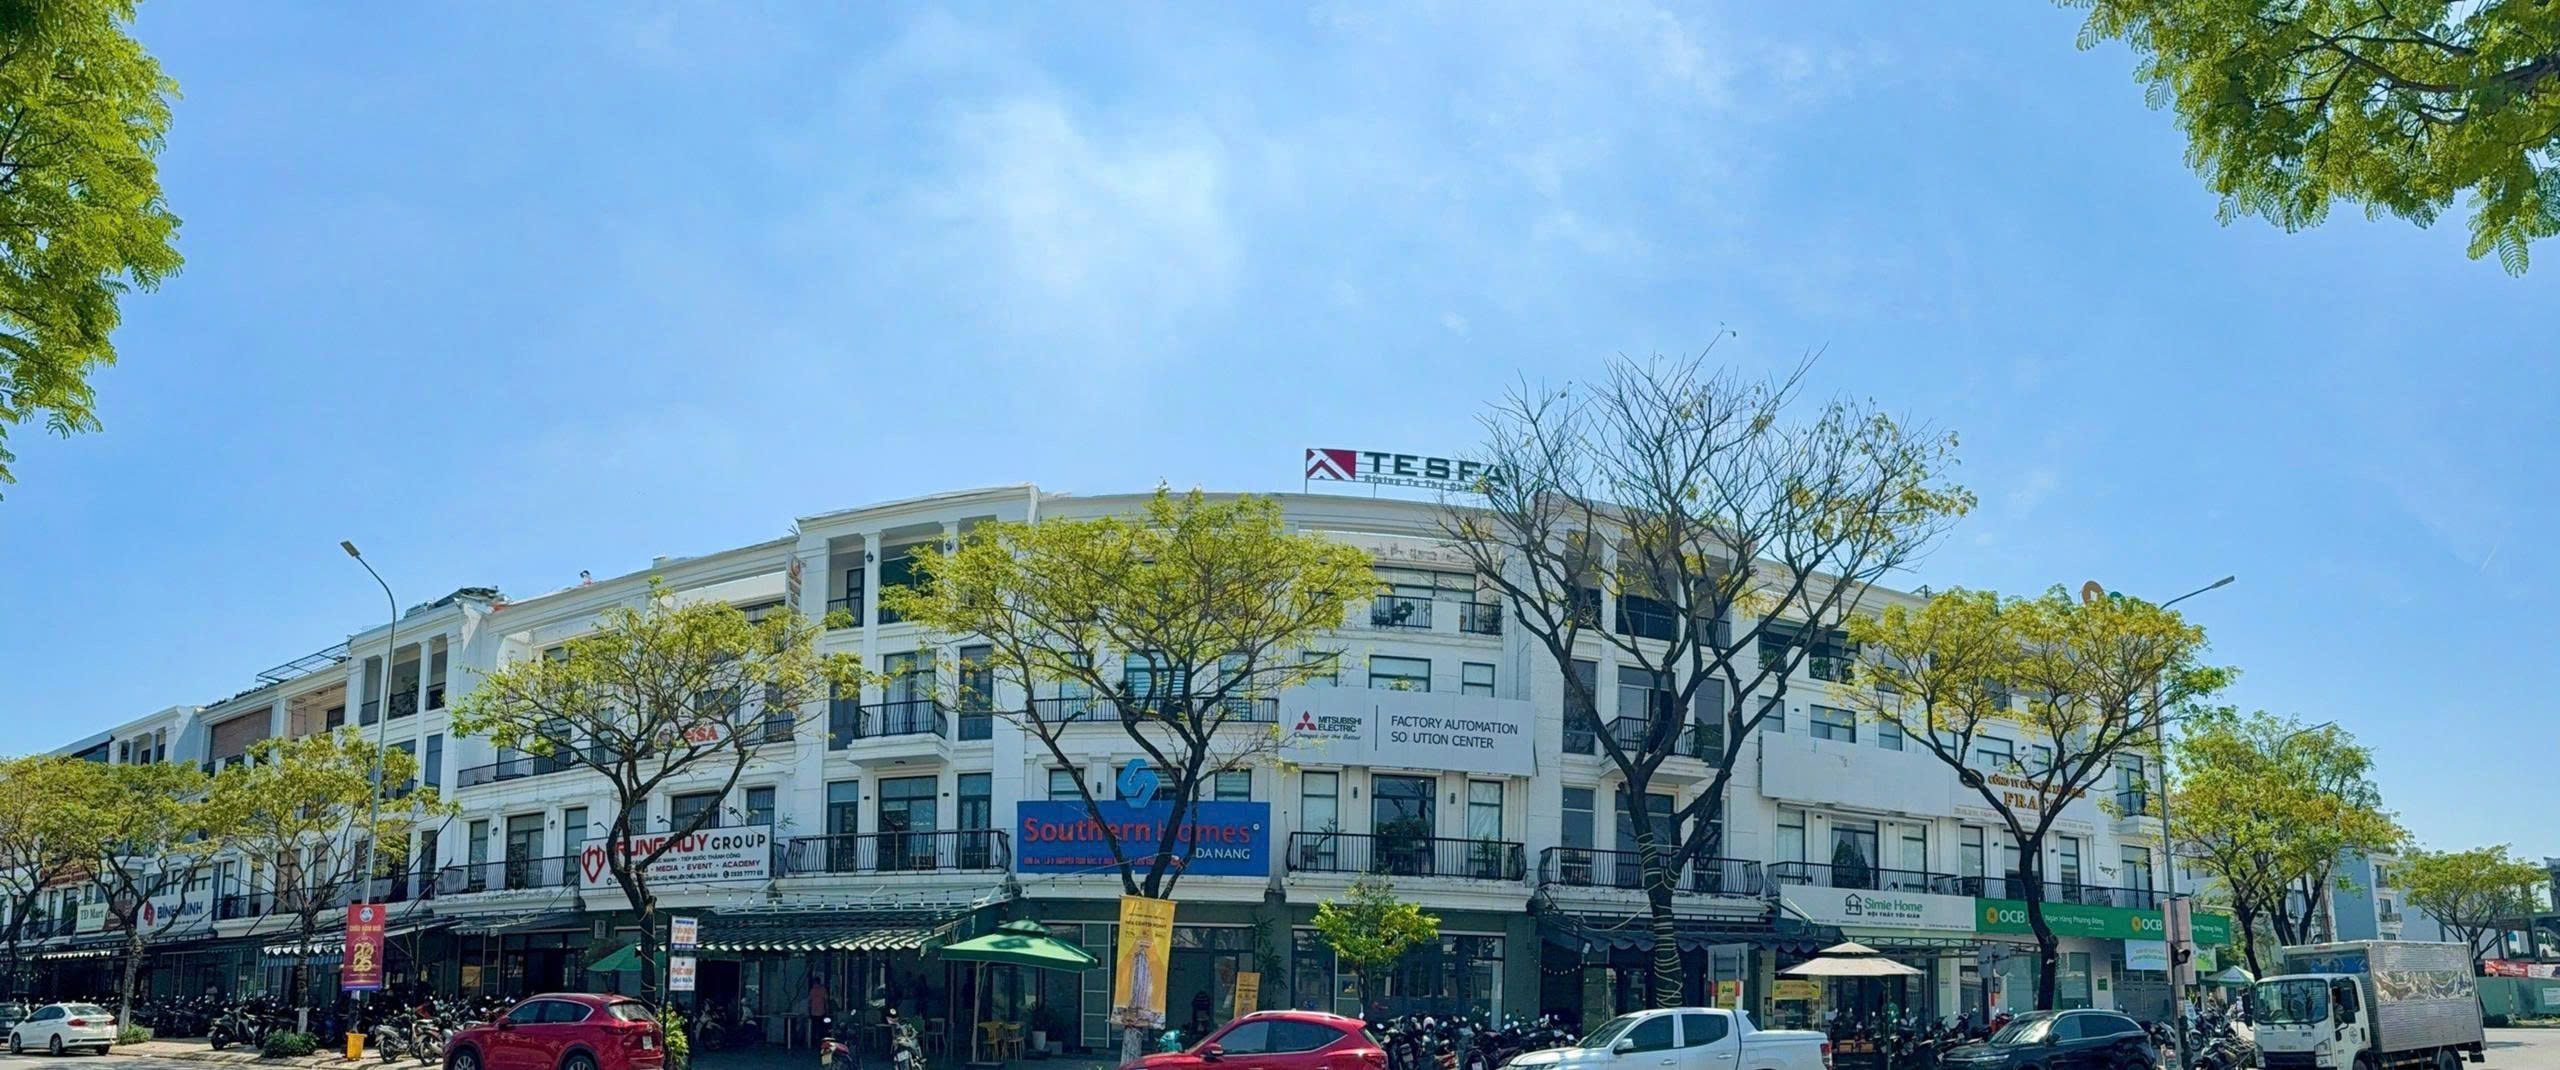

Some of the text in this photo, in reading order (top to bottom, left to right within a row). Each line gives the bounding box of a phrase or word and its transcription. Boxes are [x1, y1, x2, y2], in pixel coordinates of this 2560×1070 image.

[1318, 715, 1363, 726] MITSUBISHI
[1391, 715, 1519, 736] FACTORY AUTOMATION
[1318, 724, 1357, 733] ELECTRIC
[1452, 735, 1495, 749] CENTER
[2003, 791, 2055, 813] FRA
[1023, 816, 1151, 843] Southern
[711, 833, 766, 851] GROUP
[655, 859, 761, 872] MEDIA EVENT ACADEMY
[1894, 900, 1923, 913] Home
[1999, 909, 2026, 924] OCB
[2142, 918, 2163, 932] OCB
